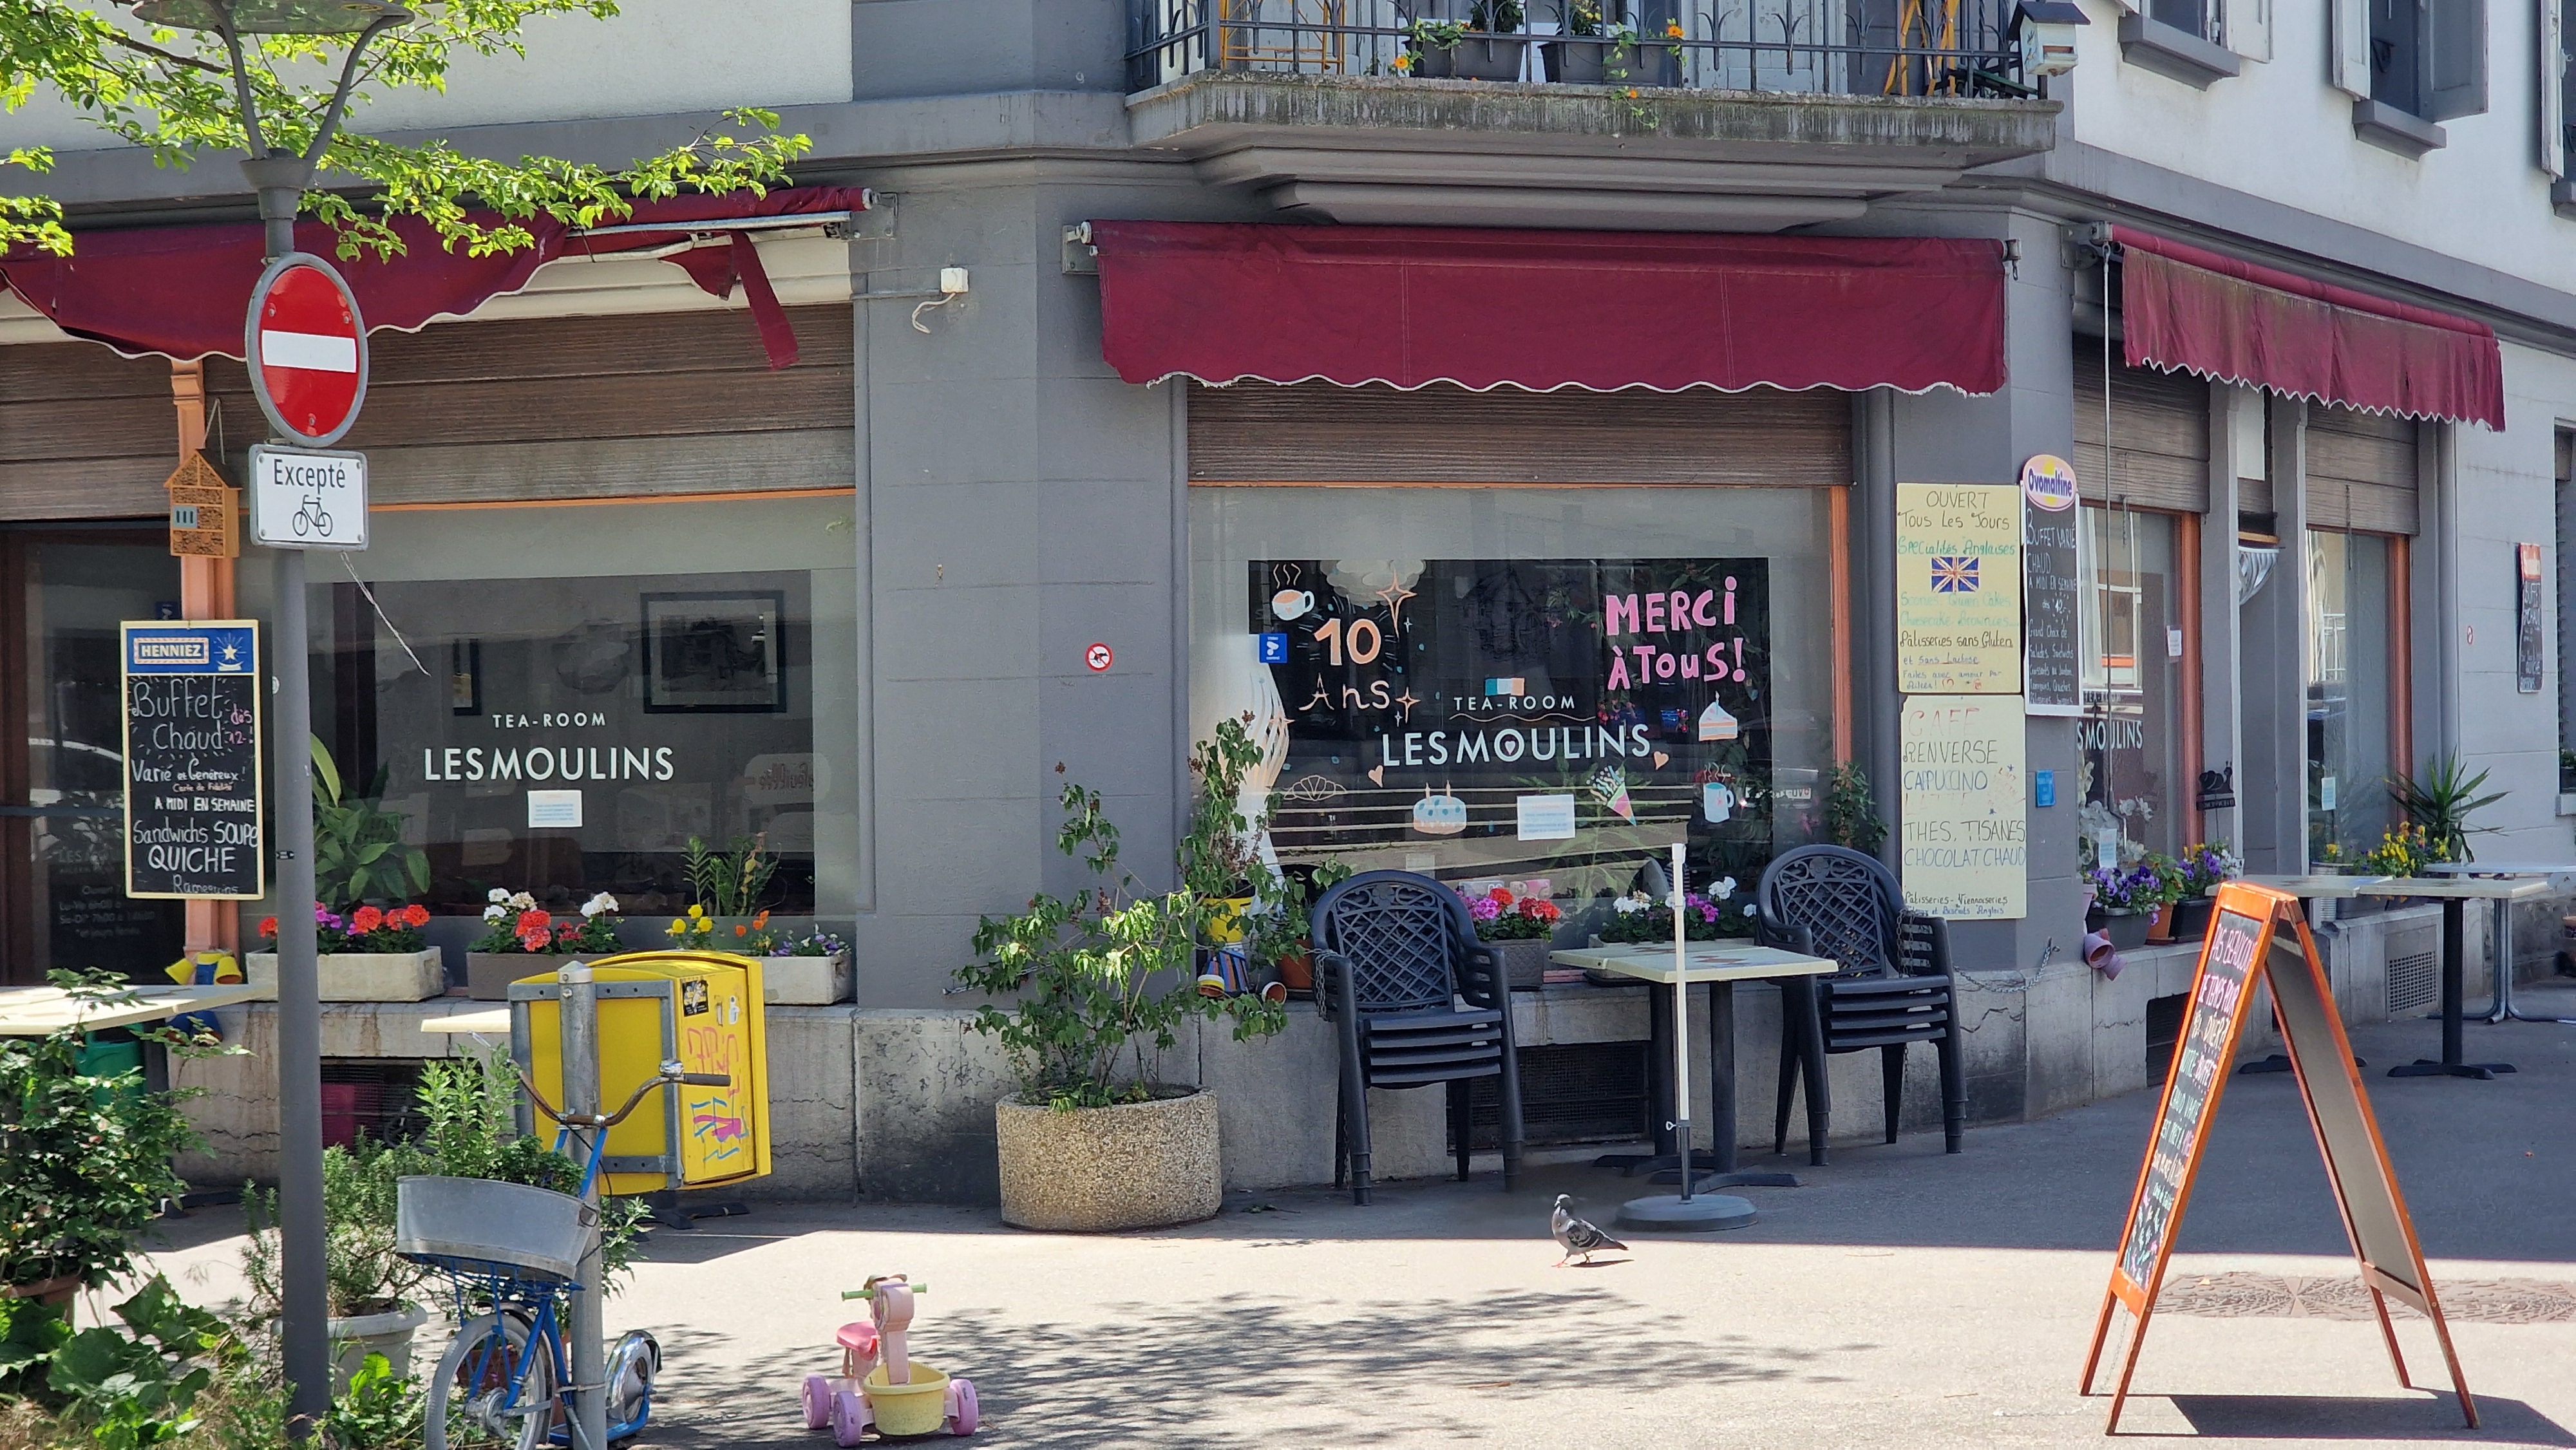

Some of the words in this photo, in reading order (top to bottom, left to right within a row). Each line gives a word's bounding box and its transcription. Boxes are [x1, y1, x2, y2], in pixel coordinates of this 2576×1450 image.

[274, 458, 345, 494] Excepté
[2029, 468, 2072, 498] Ovomaltine
[1926, 491, 1990, 509] OUVERT
[2027, 552, 2051, 574] CHAUD
[142, 644, 202, 657] HENNIEZ
[1314, 617, 1381, 666] 10
[1607, 645, 1631, 691] À
[1454, 695, 1575, 711] TEA-ROOM
[492, 711, 607, 728] TEA-ROOM
[1908, 708, 1980, 737] CAFE
[153, 720, 223, 749] Chaud
[1903, 740, 1998, 764] RENVERSE
[131, 759, 171, 782] Varié
[166, 796, 187, 811] MIDI
[194, 796, 209, 811] EN
[211, 798, 255, 812] SEMAINE
[1960, 820, 2025, 842] TISANES
[148, 844, 236, 873] QUICHE
[1904, 848, 1982, 867] CHOCOLAT
[1984, 846, 2025, 867] CHAUD
